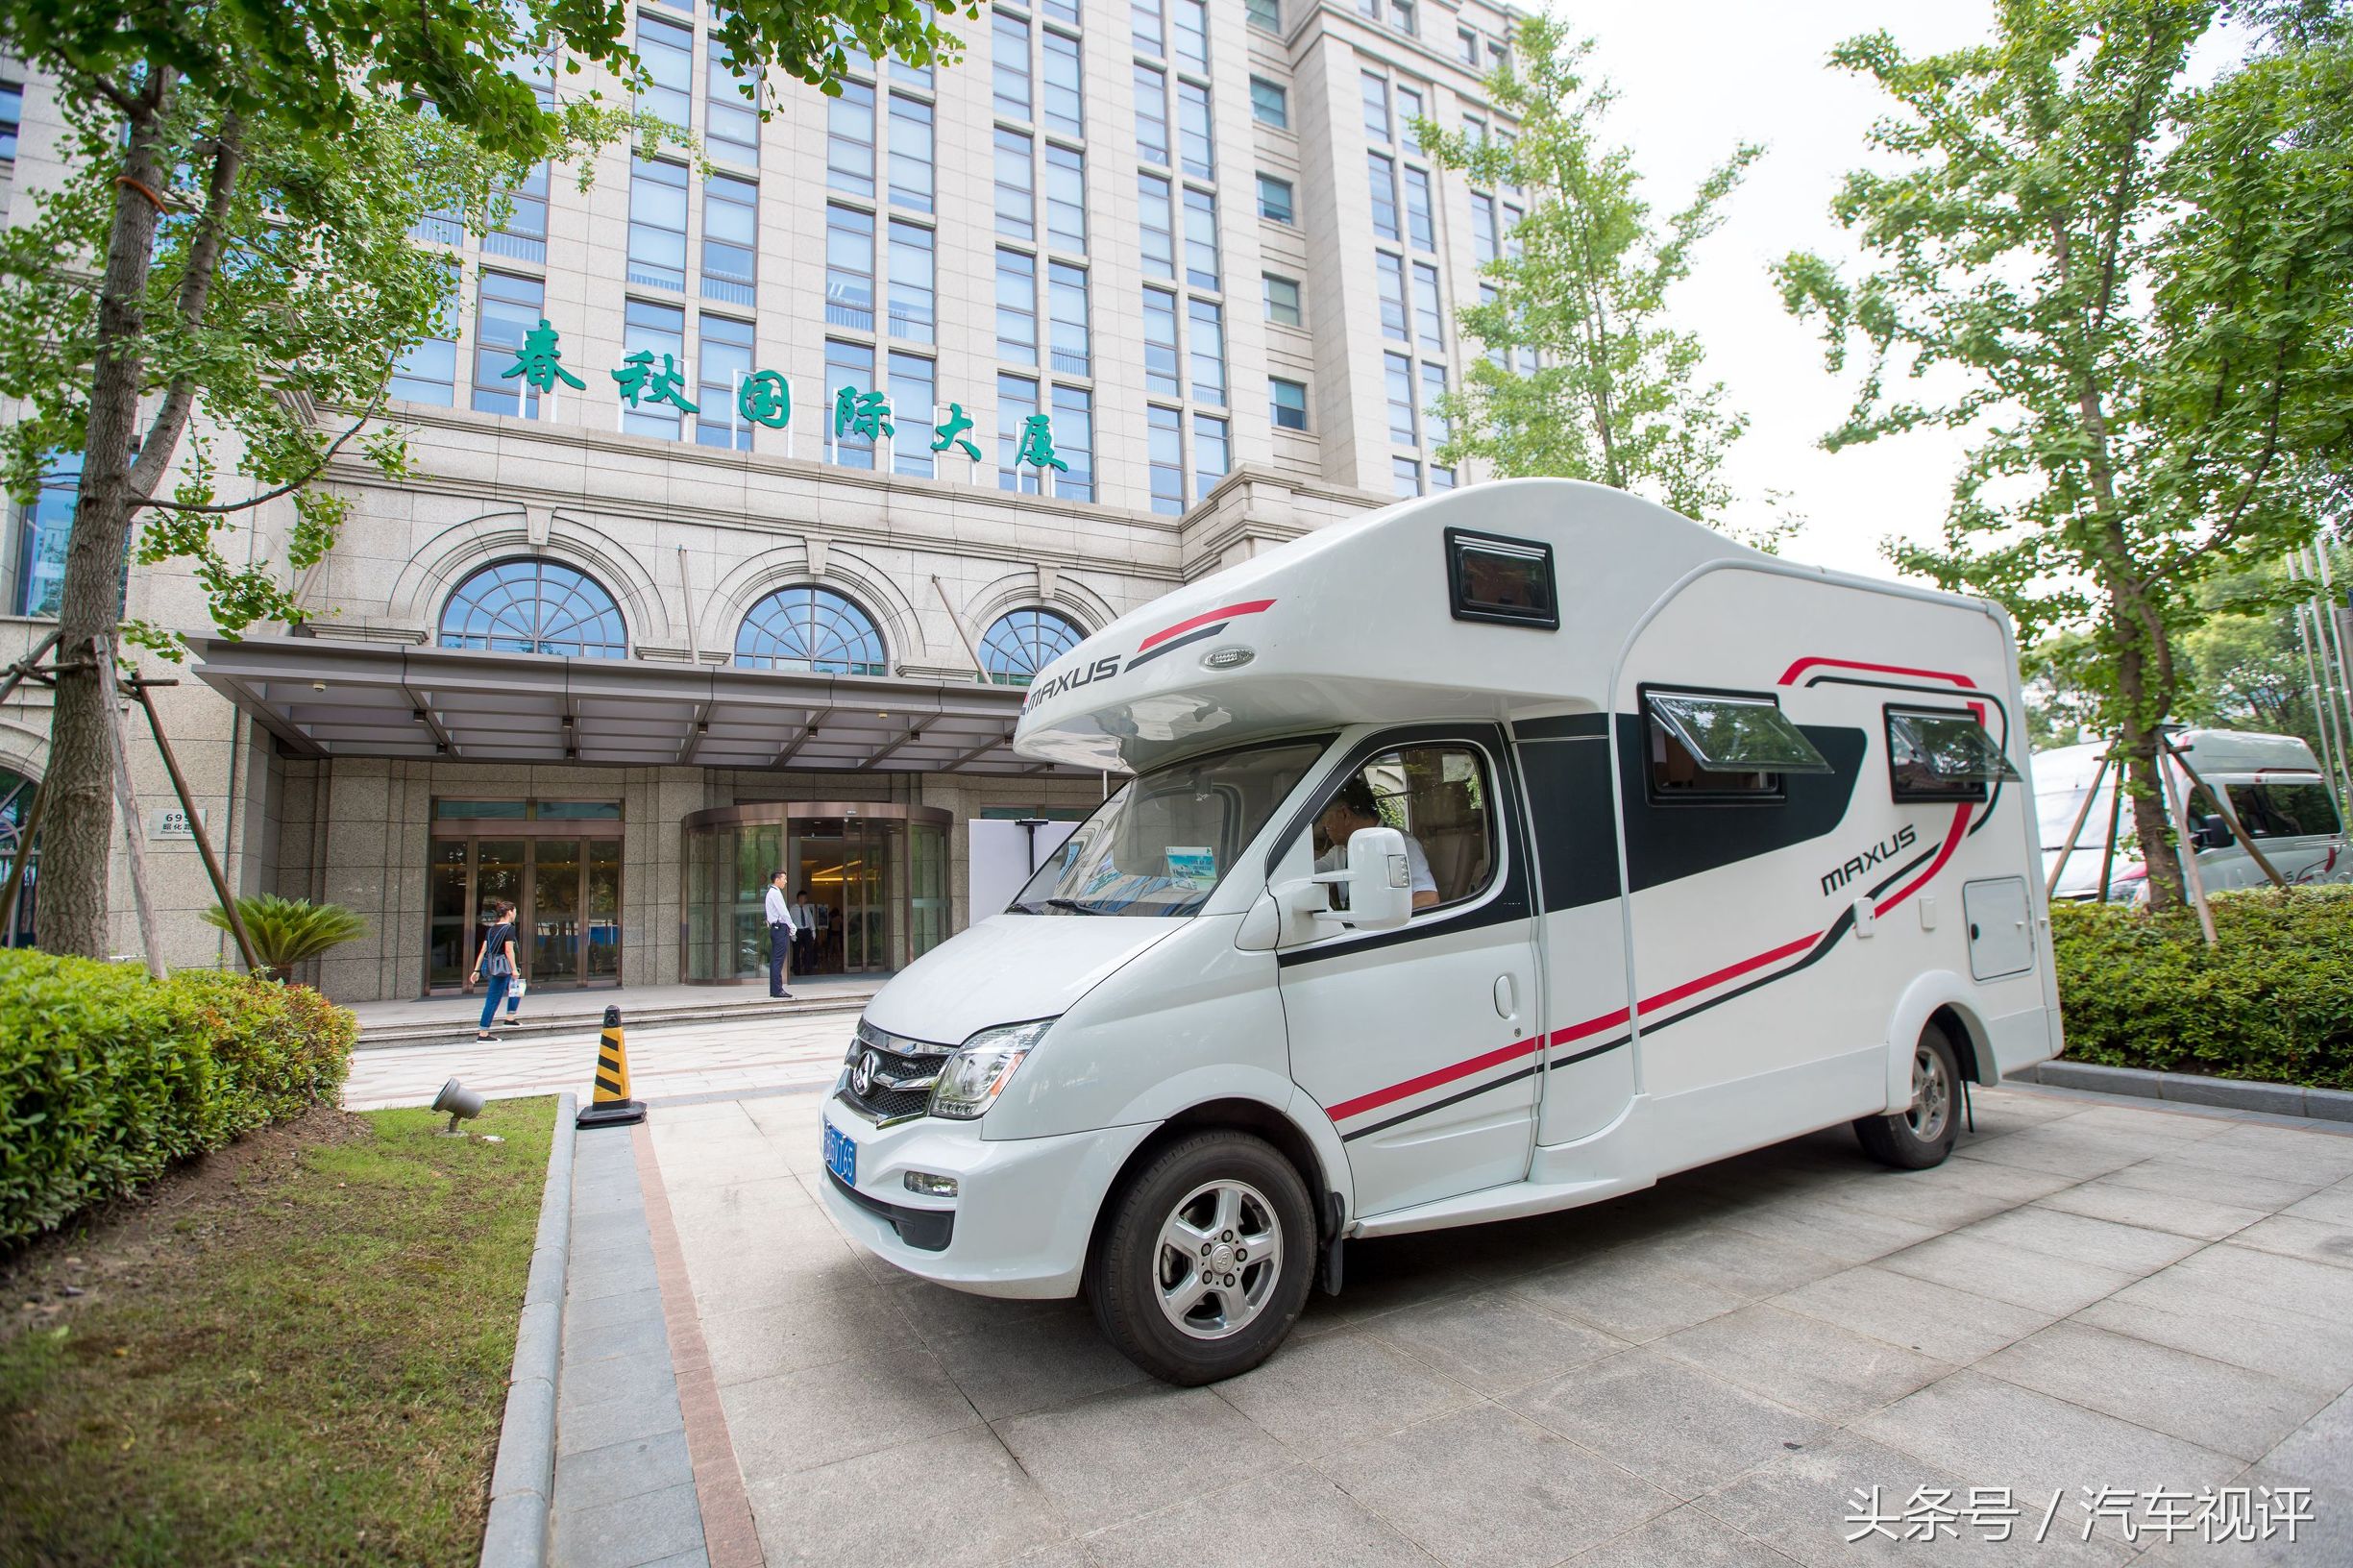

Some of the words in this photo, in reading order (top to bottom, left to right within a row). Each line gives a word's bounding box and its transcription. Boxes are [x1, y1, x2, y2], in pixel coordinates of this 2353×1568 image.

[502, 319, 1068, 473] 春秋国际大厦
[1026, 654, 1121, 714] MAXUS
[1821, 823, 1916, 896] MAXUS
